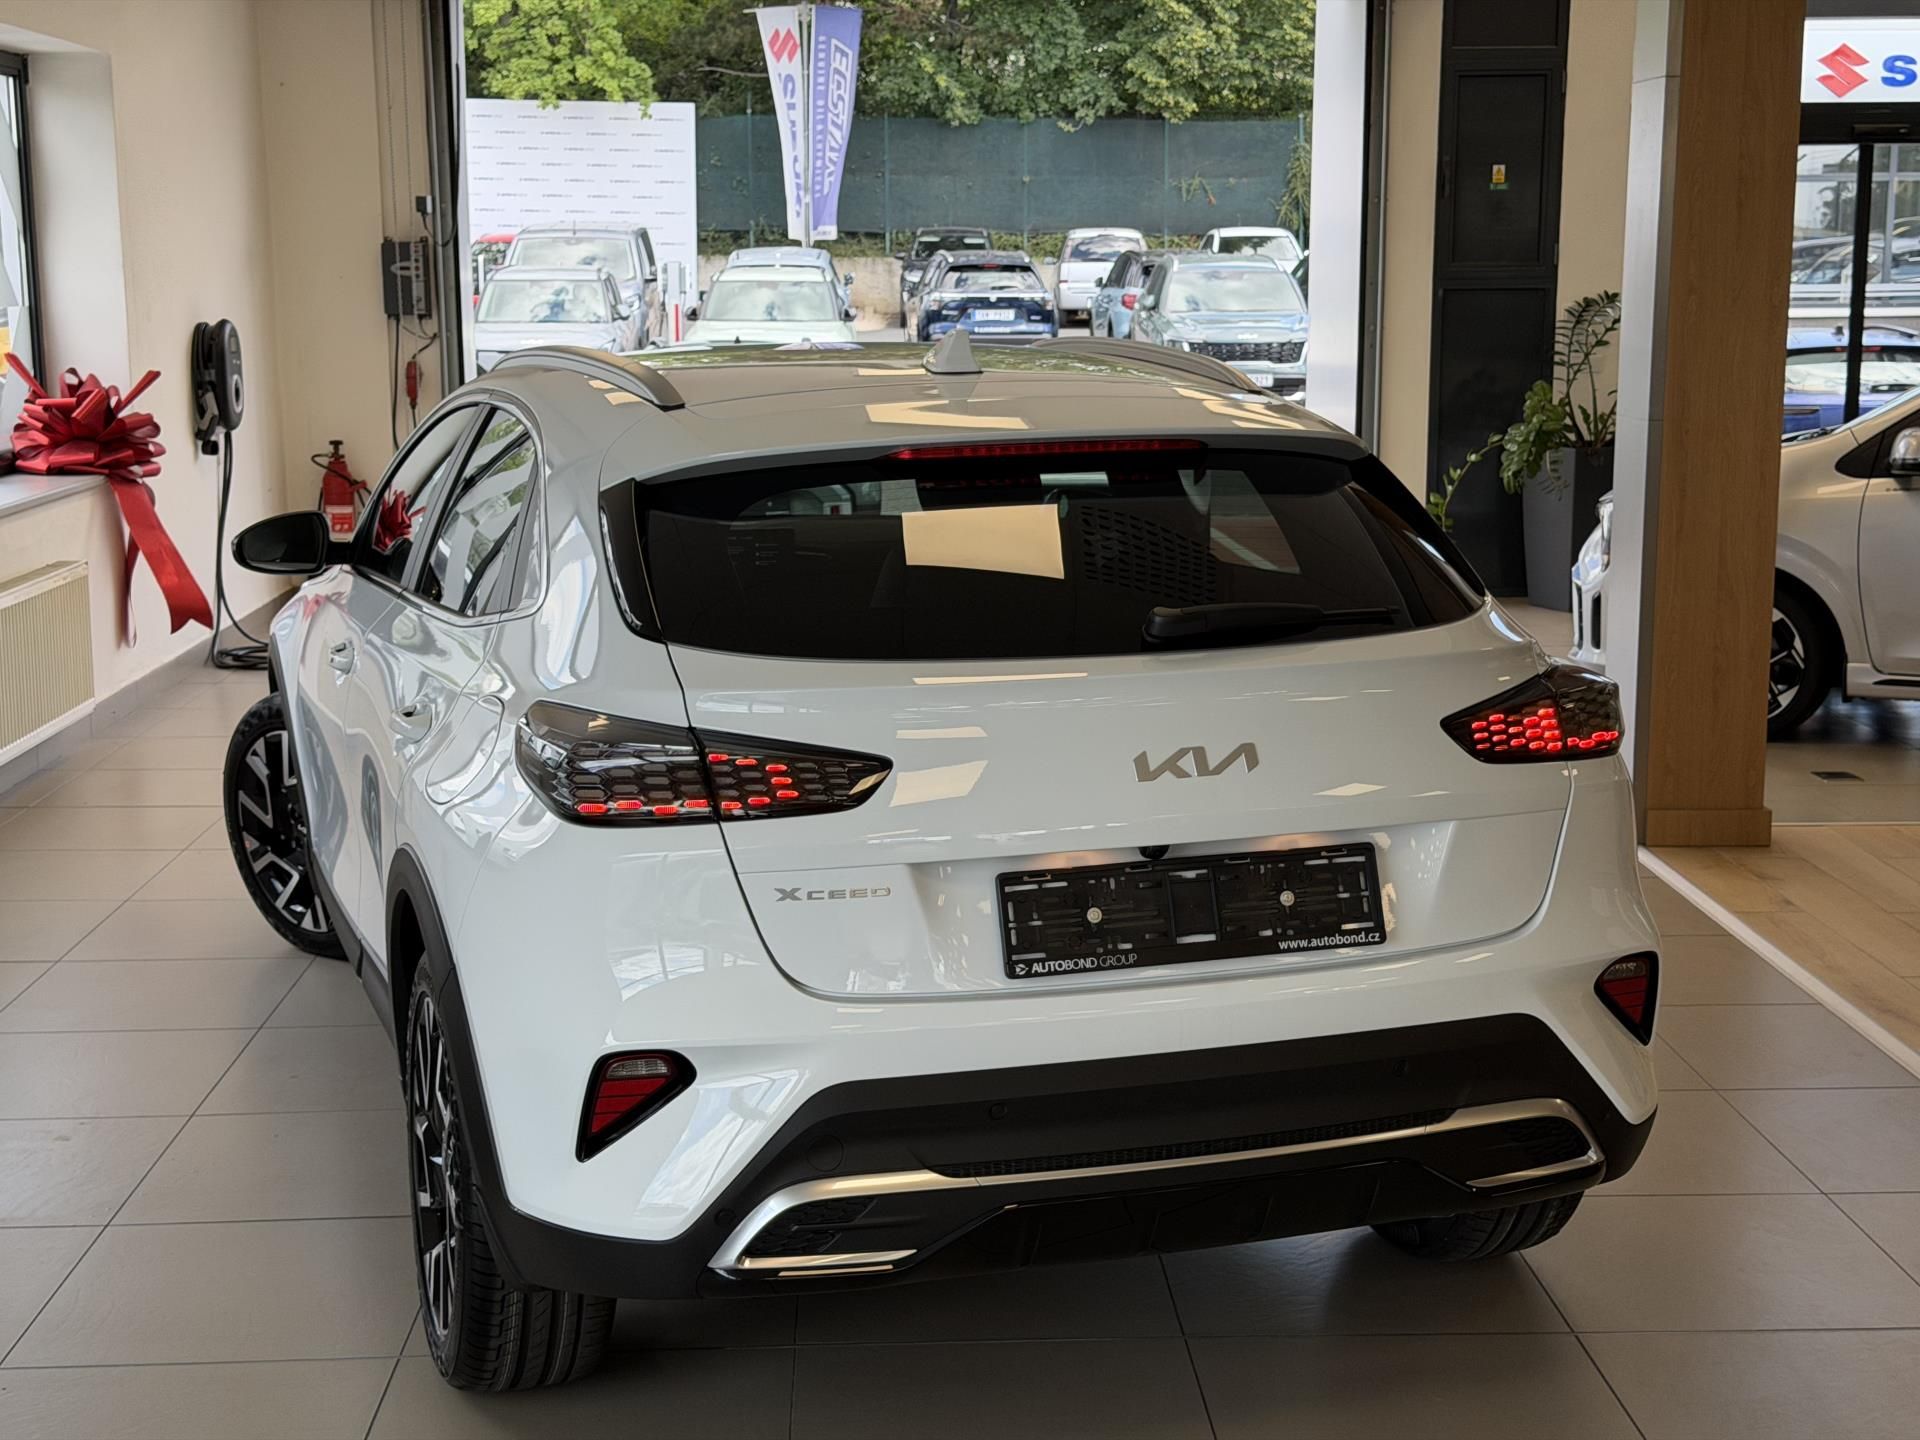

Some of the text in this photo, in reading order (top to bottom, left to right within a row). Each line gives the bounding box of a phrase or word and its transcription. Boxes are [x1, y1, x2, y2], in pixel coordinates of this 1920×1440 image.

[1880, 54, 1918, 88] S
[1133, 742, 1260, 782] KIA
[774, 887, 892, 902] XCEED
[1278, 931, 1381, 950] www.autobond.cz
[1031, 953, 1138, 974] AUTOBOND GROUP
